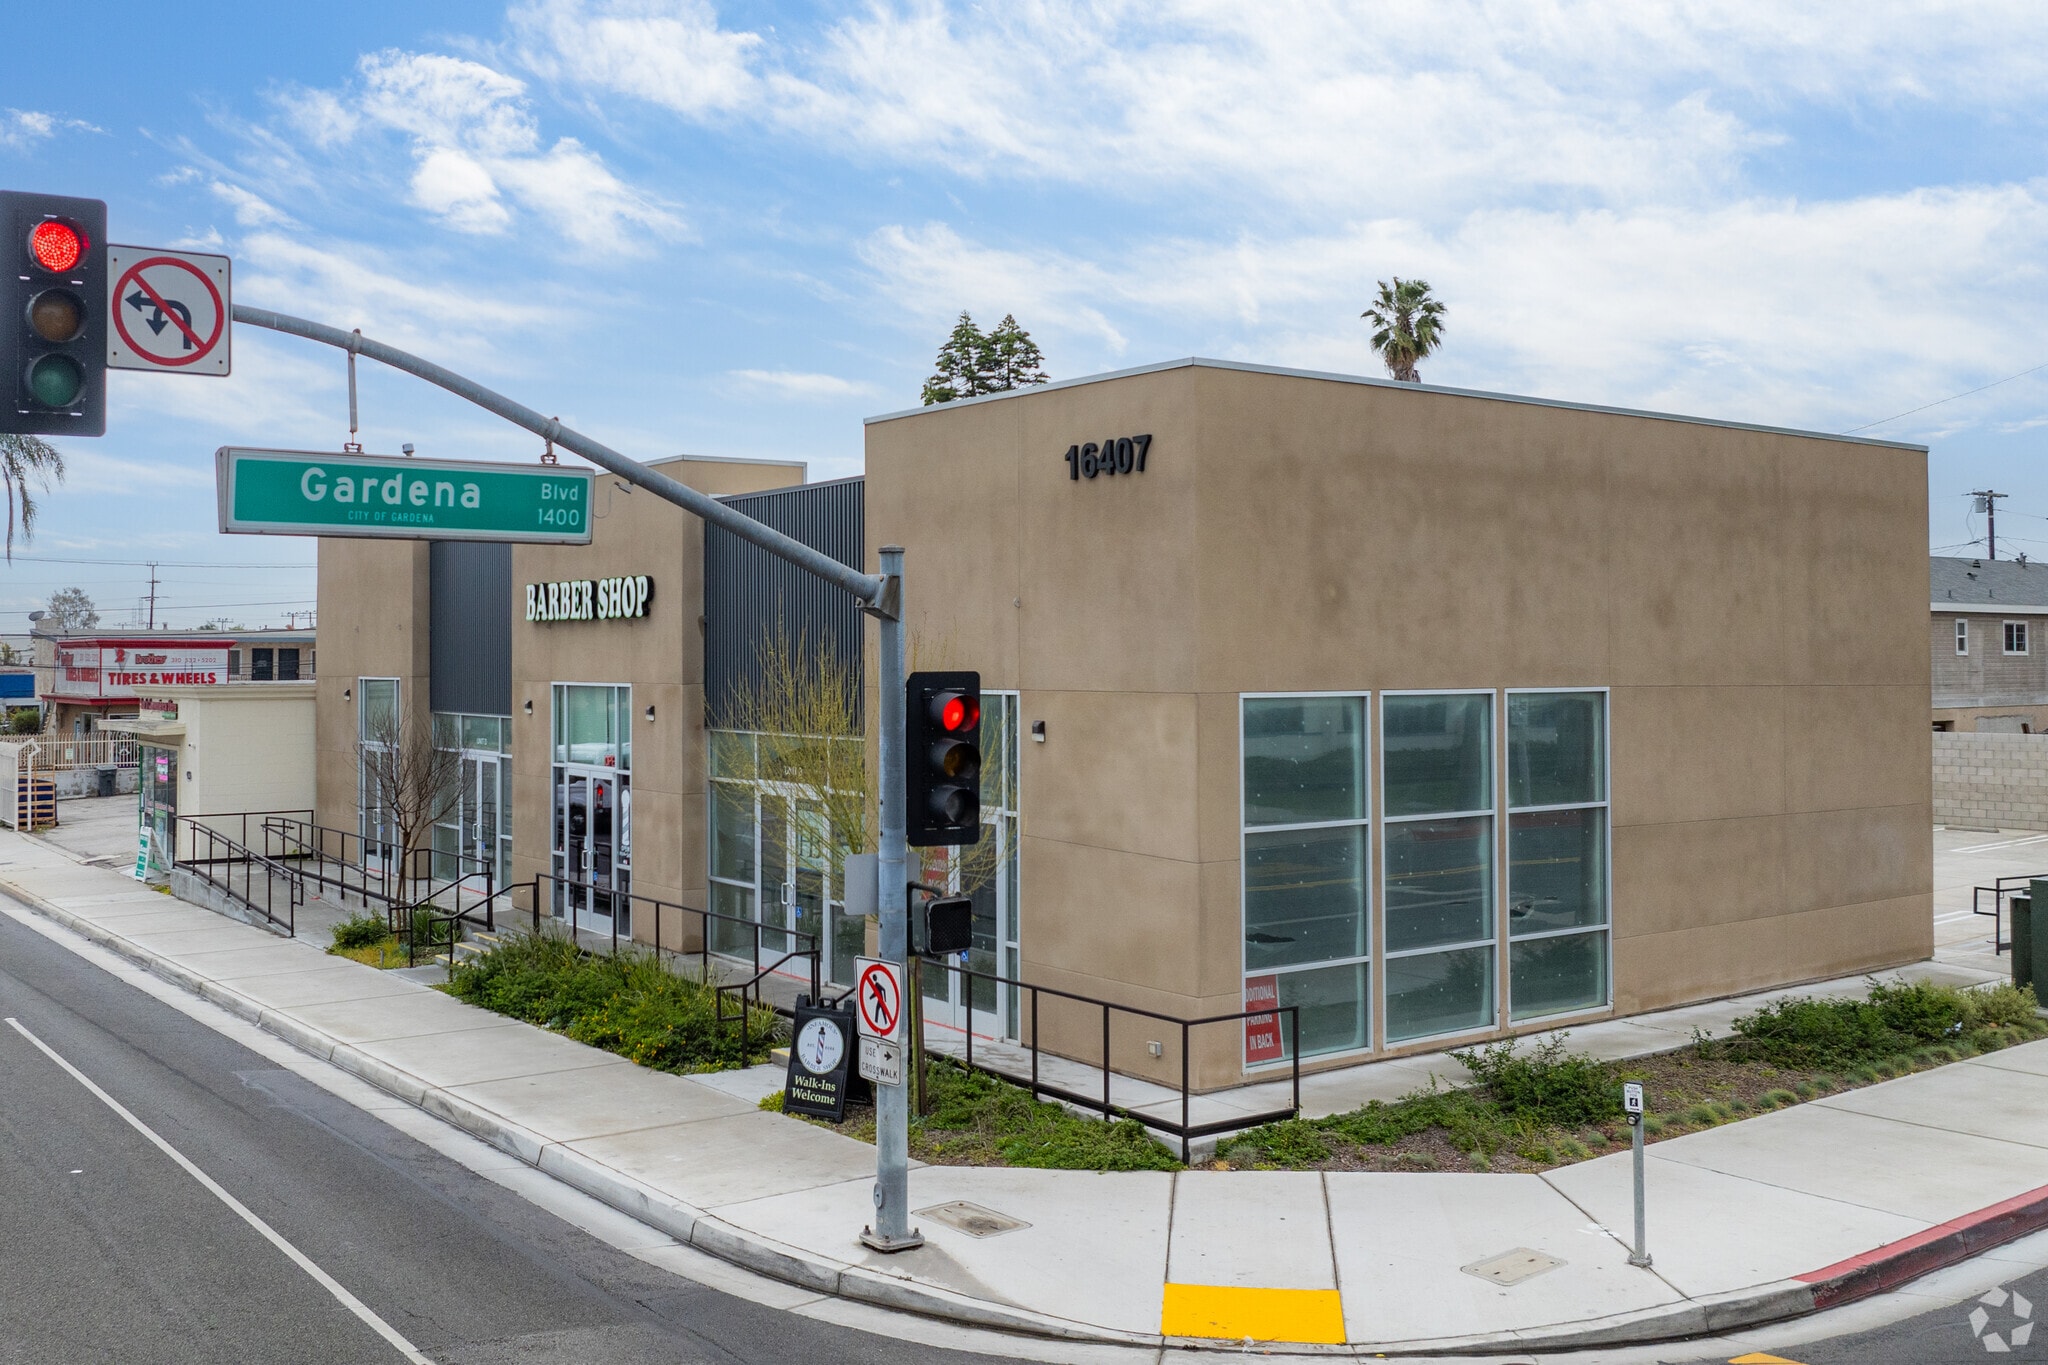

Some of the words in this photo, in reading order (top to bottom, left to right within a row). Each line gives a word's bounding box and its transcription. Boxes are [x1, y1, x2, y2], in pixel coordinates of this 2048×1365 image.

[1065, 434, 1152, 481] 16407
[301, 467, 480, 508] Gardena
[541, 483, 579, 501] Blvd
[348, 510, 369, 520] CITY
[374, 511, 387, 521] OF
[391, 512, 434, 523] GARDENA
[538, 508, 580, 526] 1400
[525, 579, 597, 621] BARBER
[597, 575, 654, 620] SHOP
[108, 672, 147, 686] TIRES
[149, 673, 160, 685] &
[161, 672, 217, 686] WHEELS
[1249, 1036, 1257, 1050] IN
[1257, 1033, 1274, 1049] BACK
[865, 1046, 876, 1057] USE
[861, 1061, 898, 1079] CROSSWALK
[795, 1075, 836, 1092] Walk-Ins
[792, 1087, 836, 1105] Welcome
